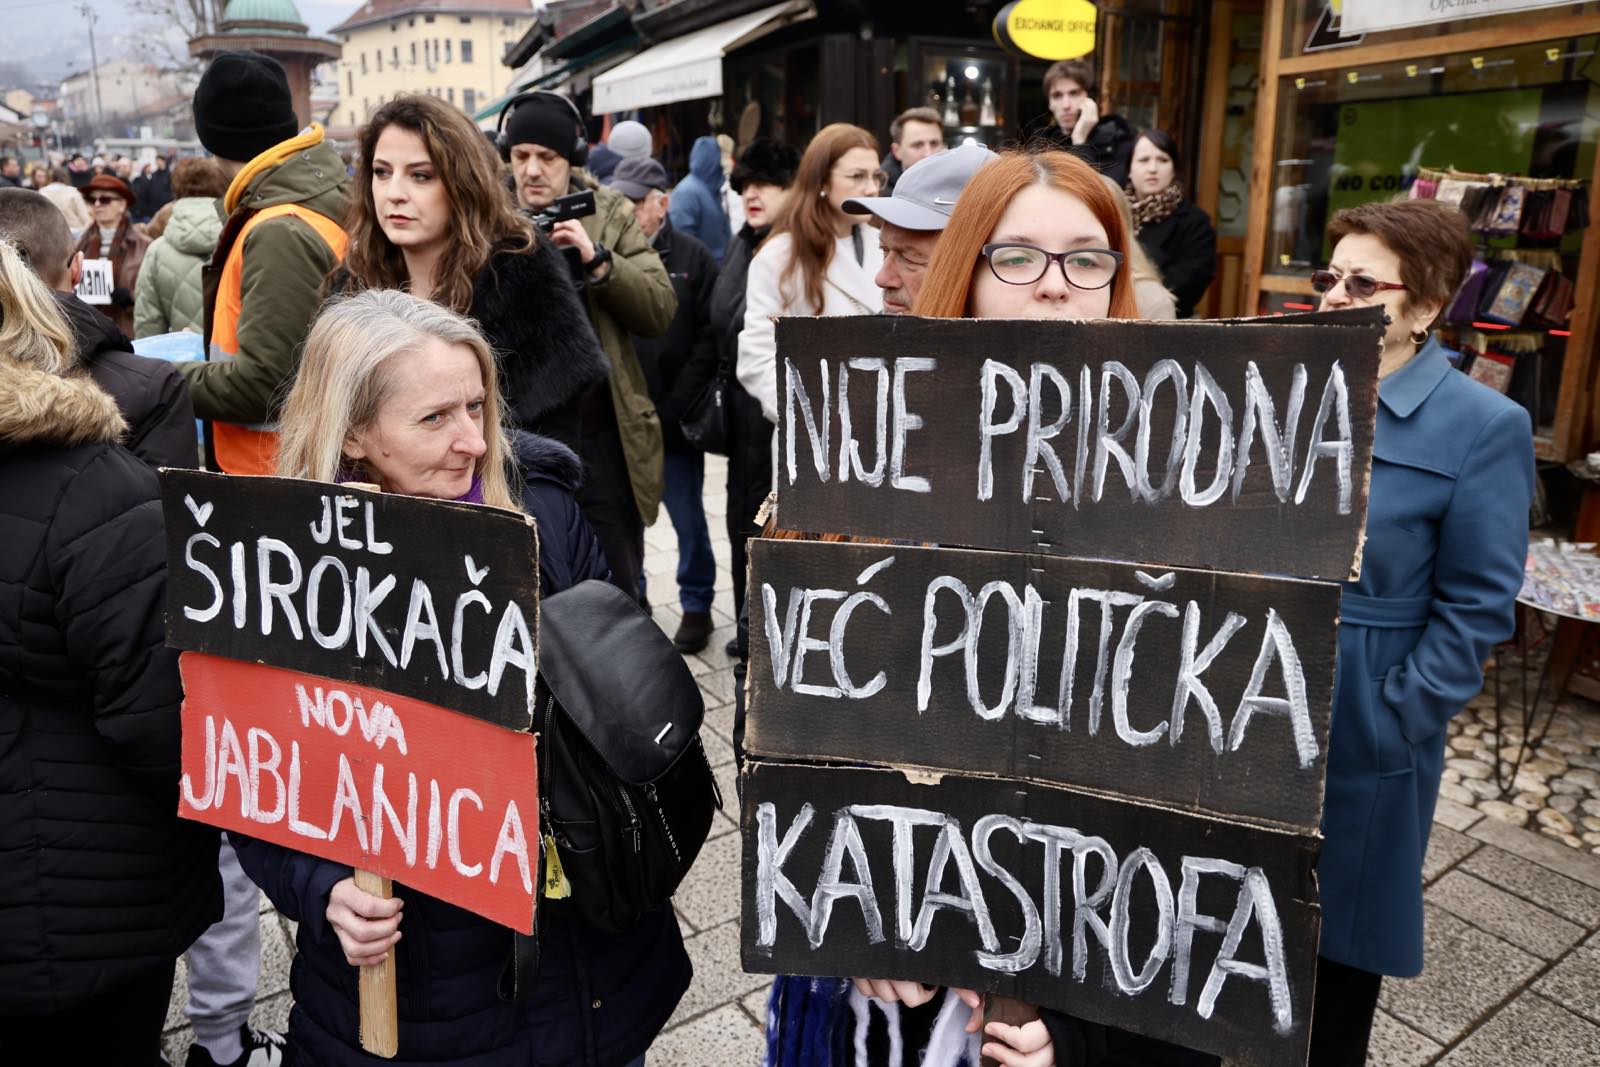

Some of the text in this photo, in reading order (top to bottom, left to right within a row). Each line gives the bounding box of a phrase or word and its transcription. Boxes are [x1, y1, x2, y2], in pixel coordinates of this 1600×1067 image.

[1015, 17, 1064, 32] EXCHANGE
[1336, 175, 1363, 190] NO
[784, 356, 1353, 515] NIJE PRIRODNA
[309, 495, 394, 555] JEL
[183, 493, 537, 714] ŠIROKAČA
[761, 556, 896, 699] VEĆ
[294, 682, 408, 755] NOVA
[182, 715, 533, 894] JABLANICA
[755, 801, 1294, 1036] KATASTROFA
